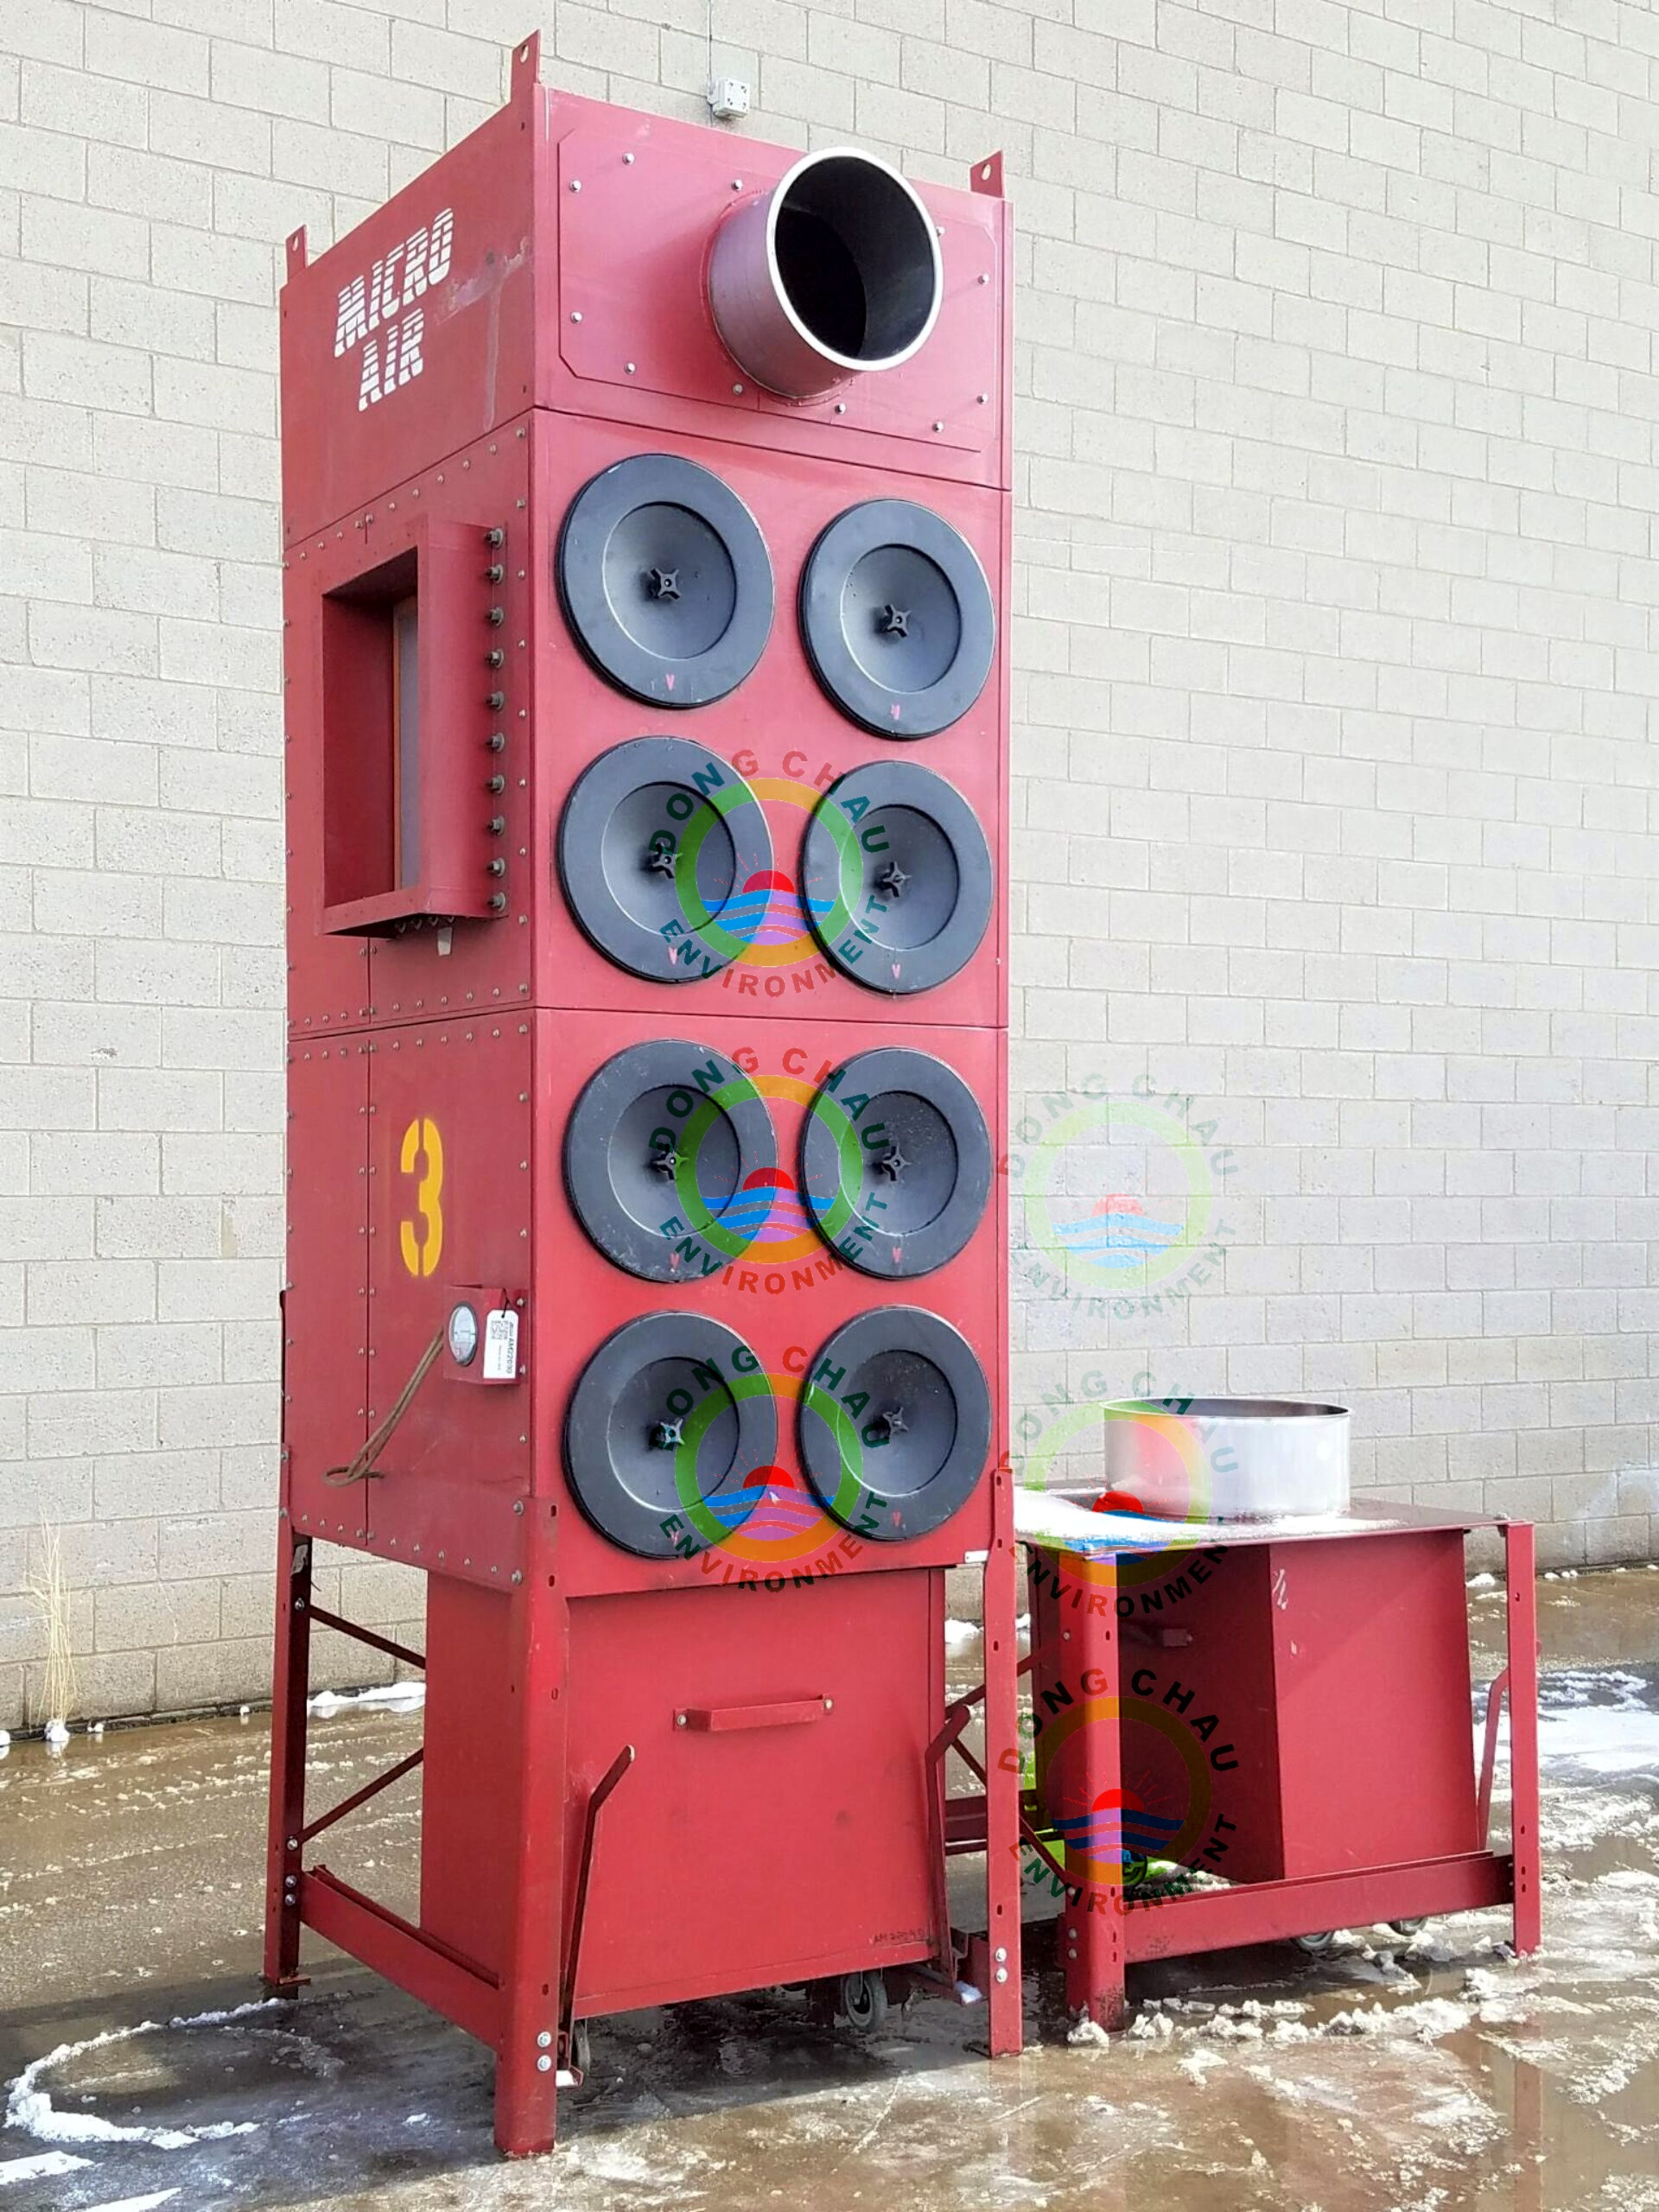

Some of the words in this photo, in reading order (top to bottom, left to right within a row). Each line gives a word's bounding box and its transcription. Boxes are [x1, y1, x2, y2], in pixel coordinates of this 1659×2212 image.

[334, 207, 454, 358] MICRO
[359, 308, 424, 412] AIR
[400, 1117, 443, 1277] 3
